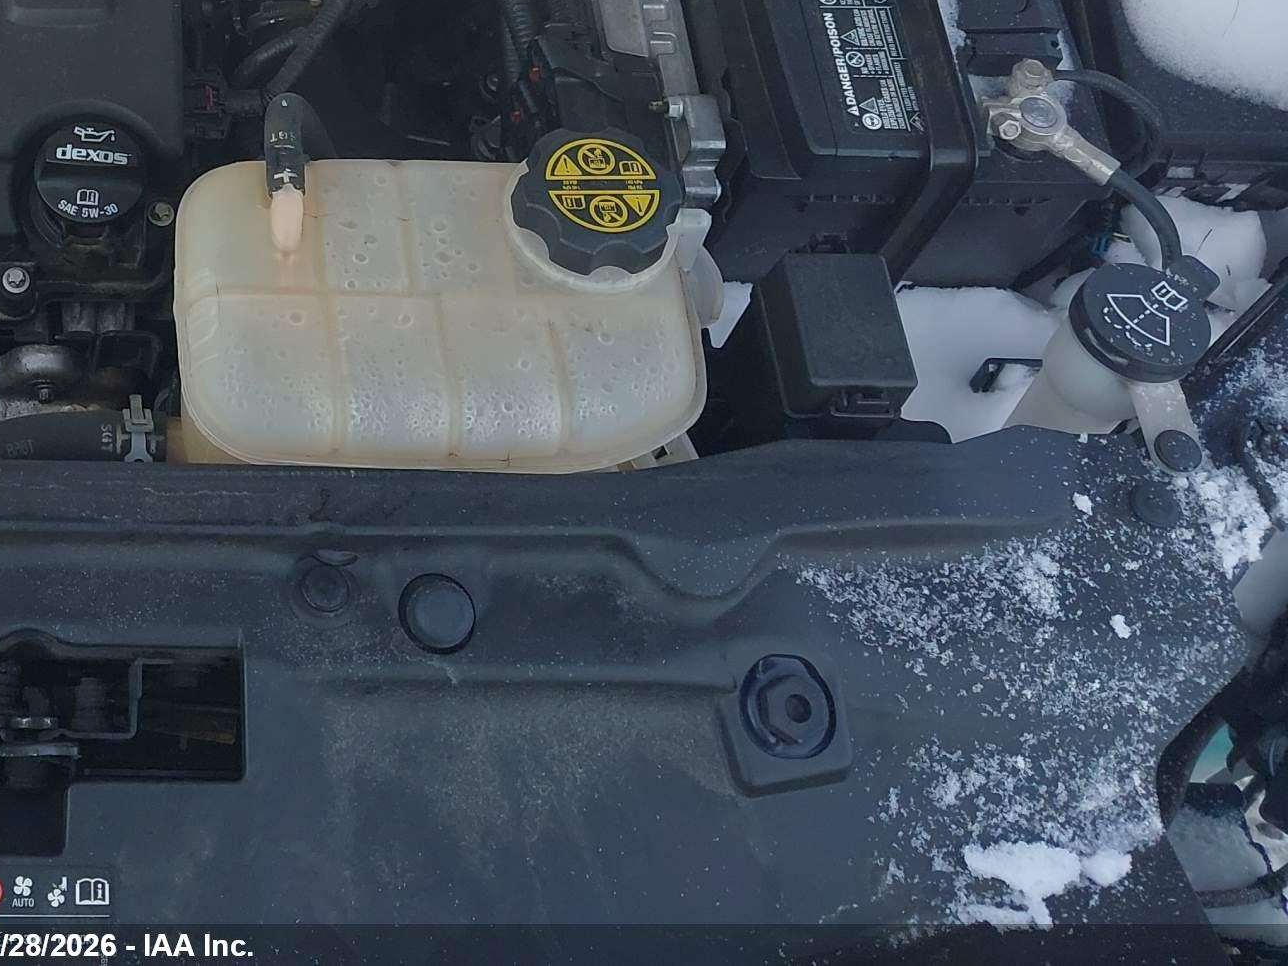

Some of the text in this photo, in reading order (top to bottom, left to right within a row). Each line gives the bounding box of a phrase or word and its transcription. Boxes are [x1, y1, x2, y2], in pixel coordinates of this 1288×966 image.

[823, 12, 857, 105] DANGER/POISON
[56, 144, 129, 165] dexos
[58, 199, 119, 219] SAE 5W-30
[12, 898, 35, 907] AUTO
